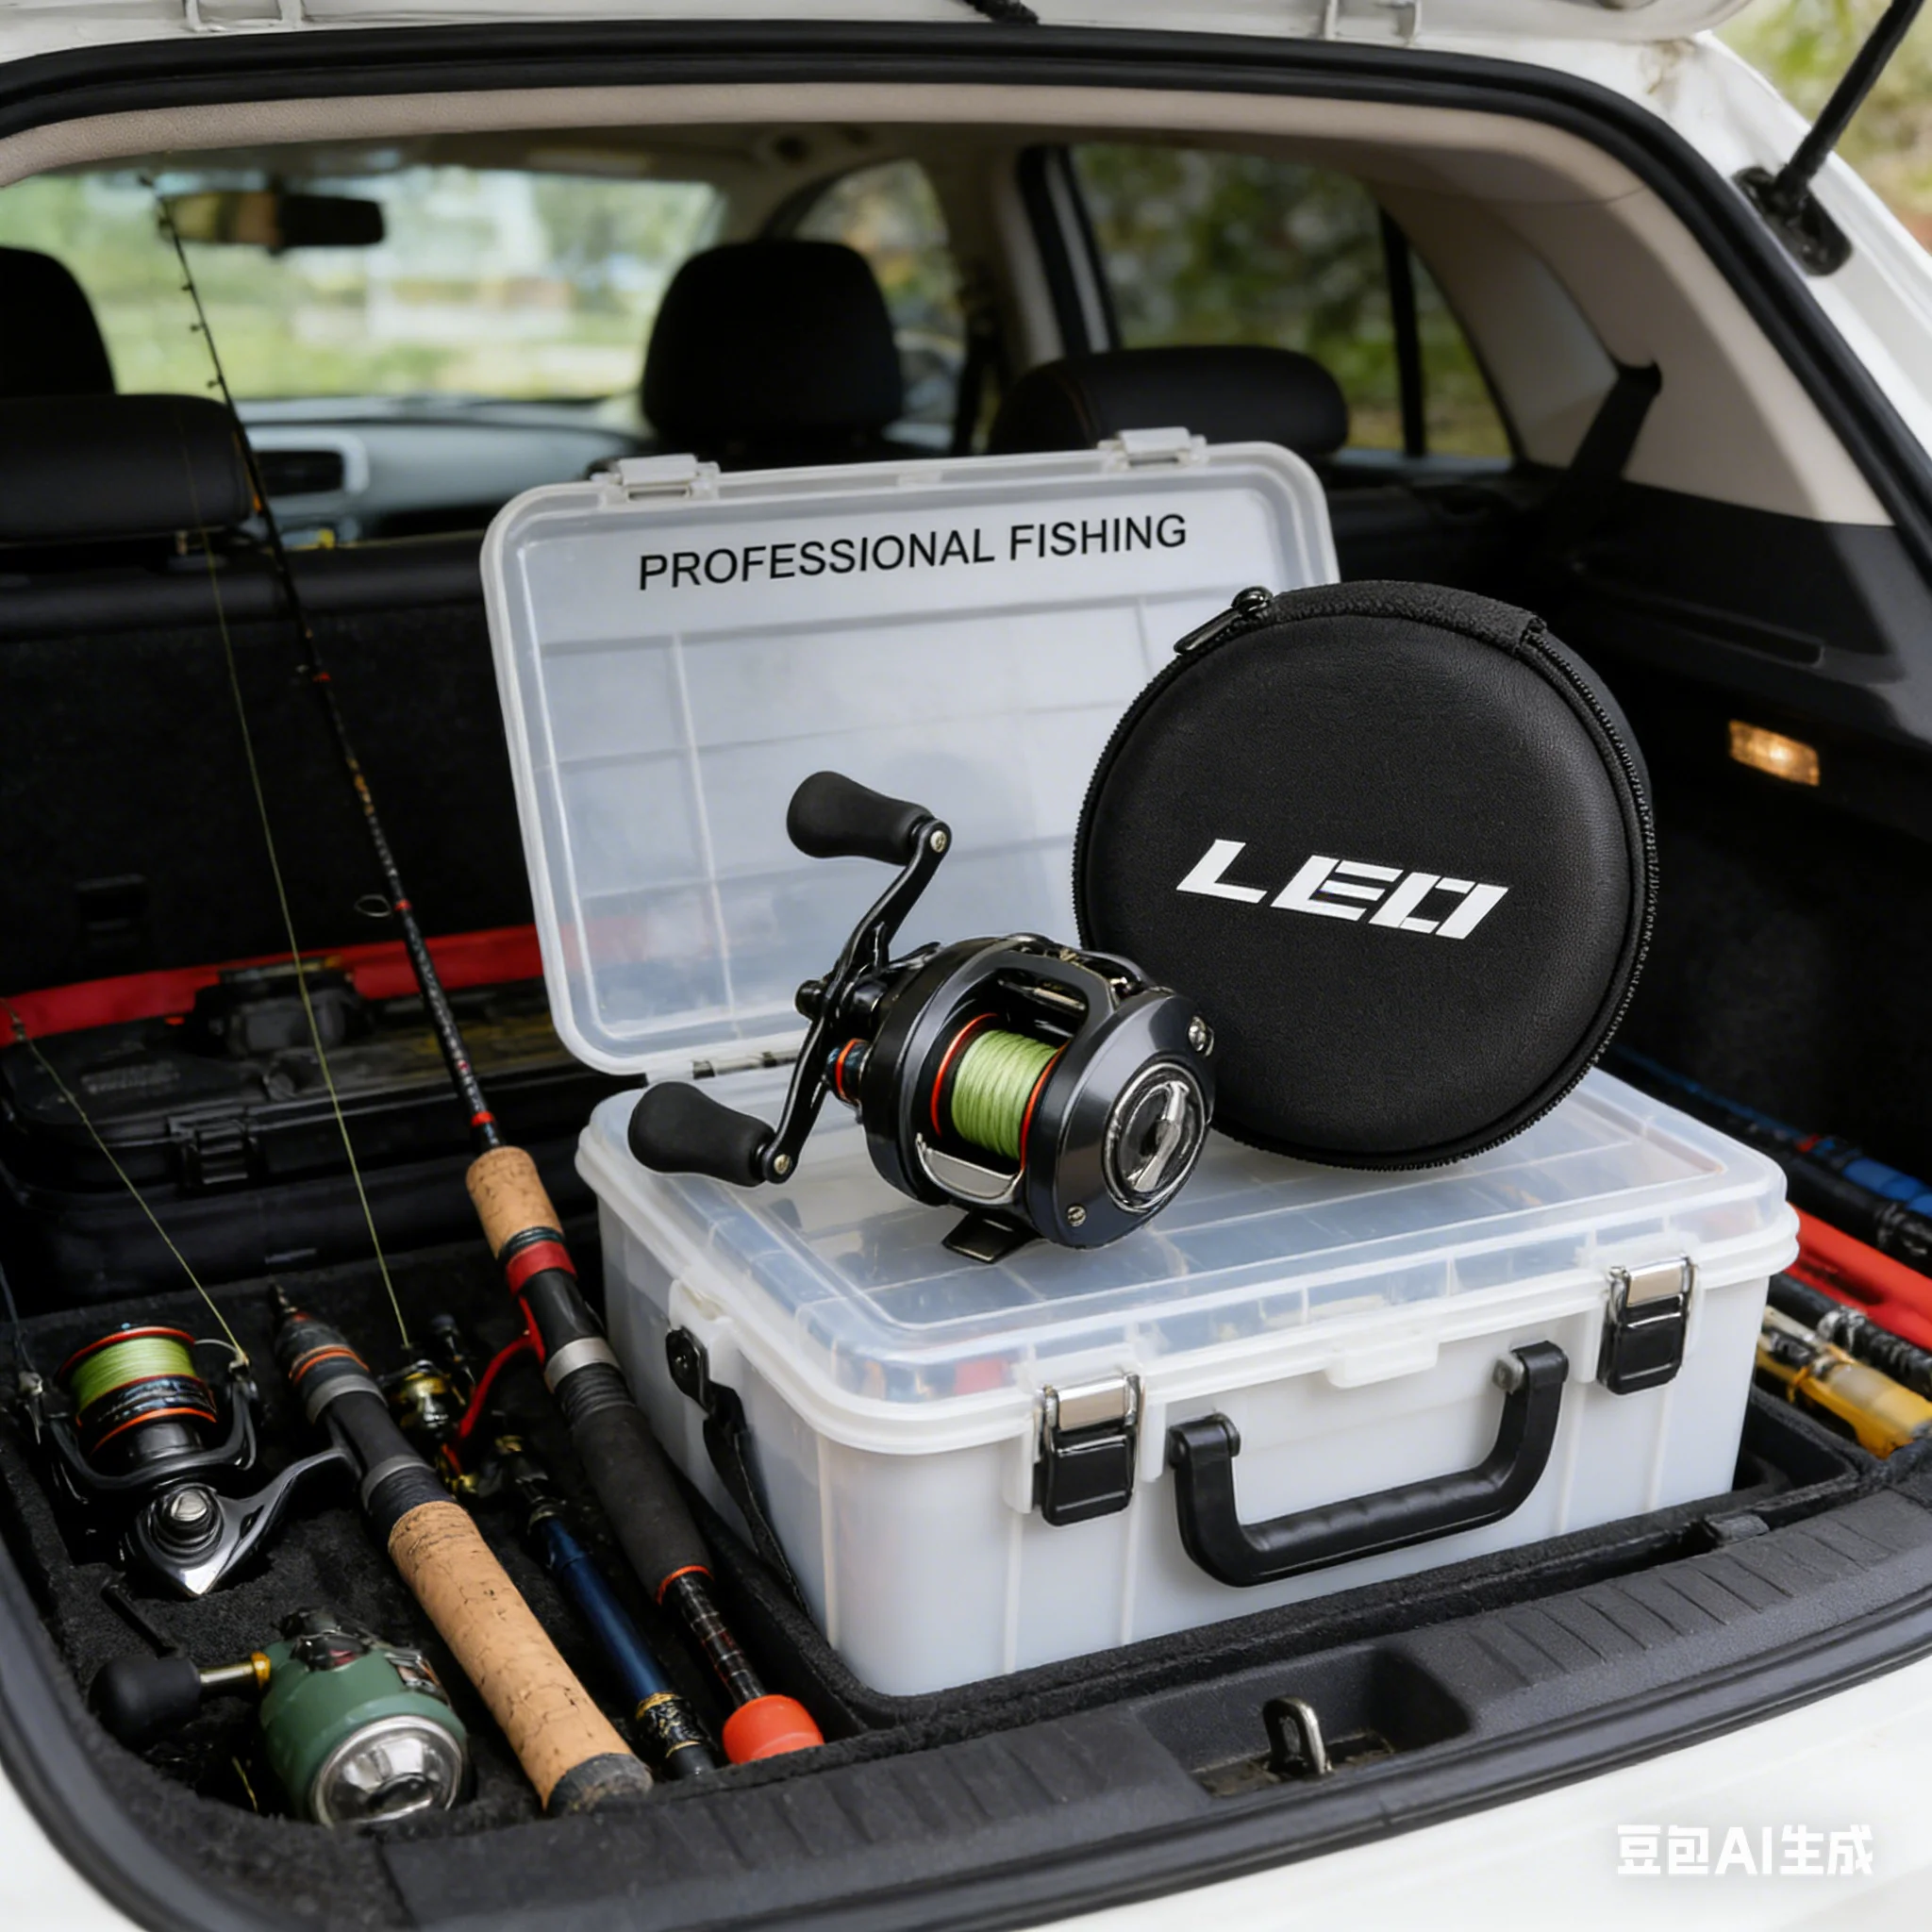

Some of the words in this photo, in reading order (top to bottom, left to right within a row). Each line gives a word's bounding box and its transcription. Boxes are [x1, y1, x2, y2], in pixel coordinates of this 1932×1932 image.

[640, 528, 995, 591] PROFESSIONAL
[1010, 513, 1186, 560] FISHING
[1175, 839, 1509, 940] LEO
